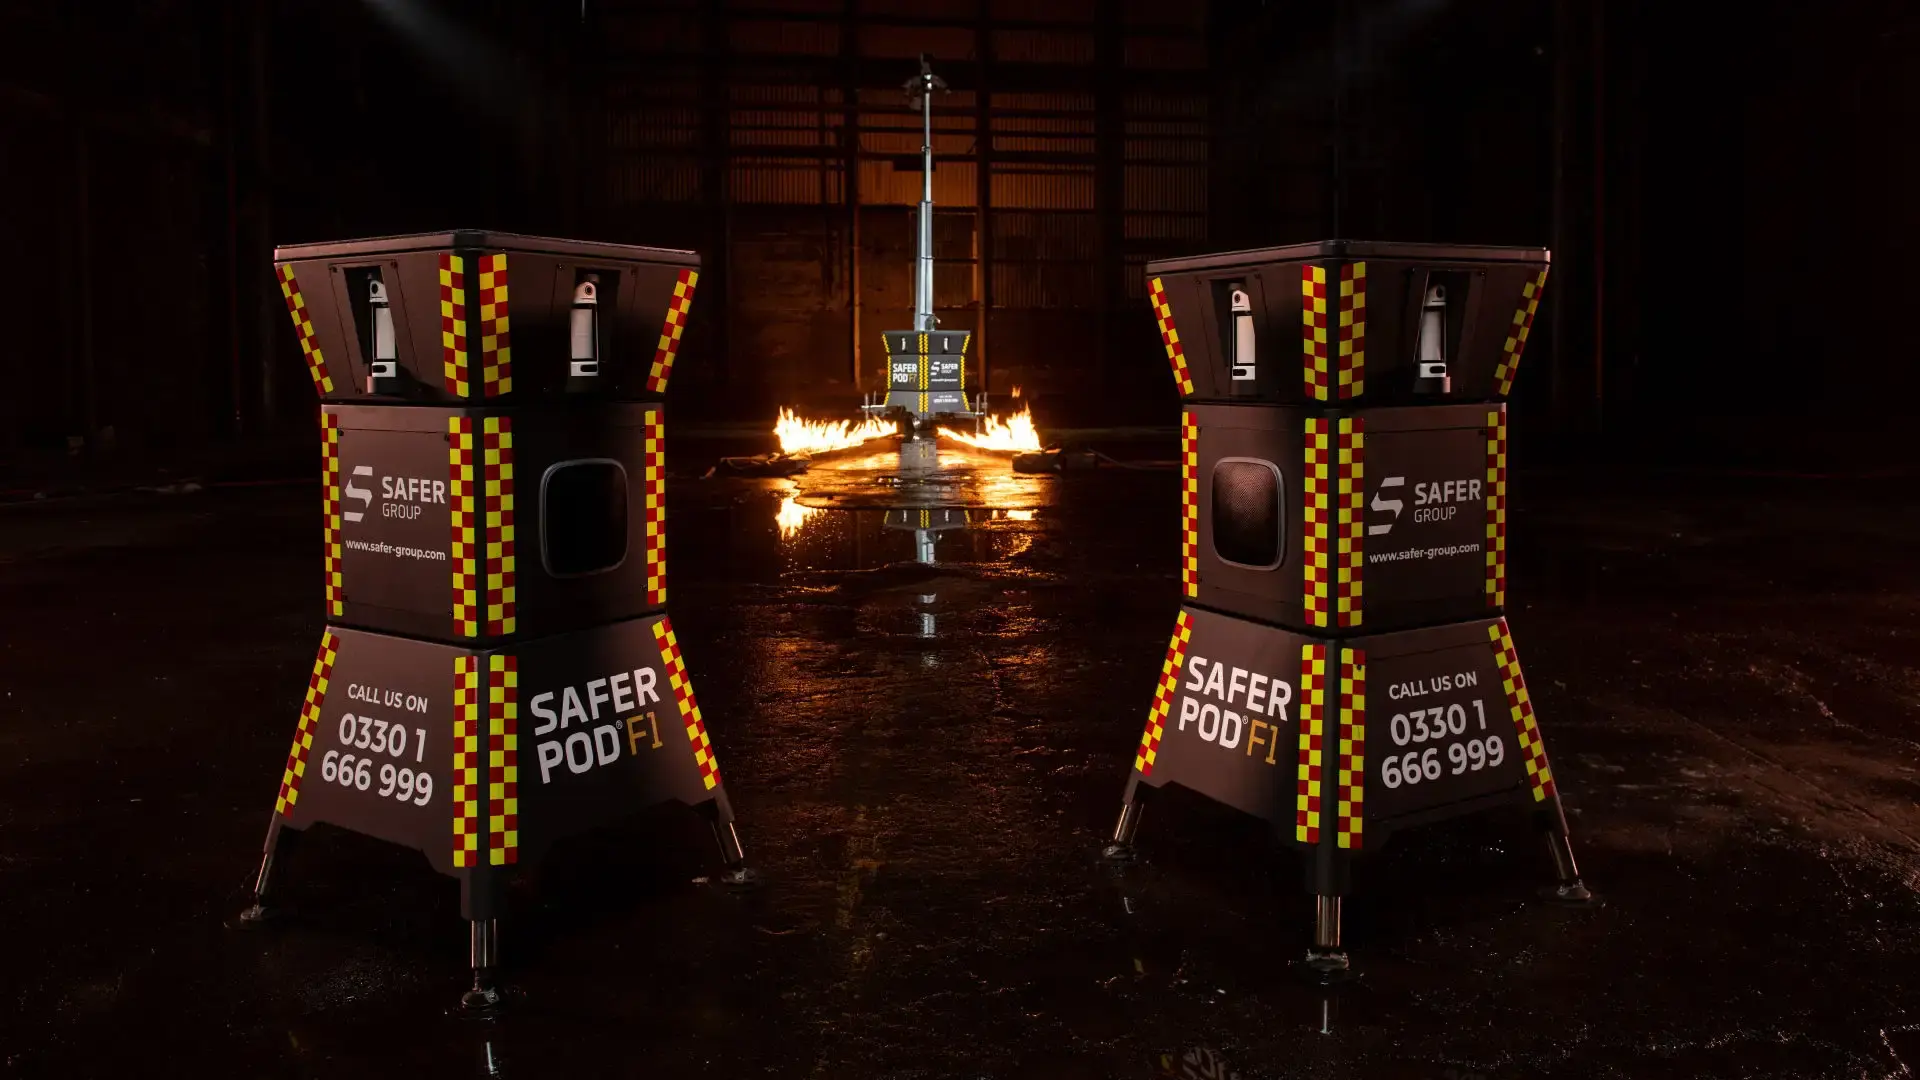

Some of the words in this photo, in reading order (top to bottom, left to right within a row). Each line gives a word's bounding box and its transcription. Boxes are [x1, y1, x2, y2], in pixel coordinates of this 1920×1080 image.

[892, 363, 917, 373] SAFER
[381, 475, 446, 505] SAFER
[1414, 478, 1482, 506] SAFER
[381, 502, 422, 520] GROUP
[1413, 505, 1457, 524] GROUP
[345, 539, 447, 561] www.safer-group.com
[1369, 542, 1480, 564] www.safer-group.com
[347, 682, 381, 706] CALL
[384, 690, 403, 709] US
[405, 694, 428, 714] ON
[529, 666, 661, 736] SAFER
[1184, 655, 1293, 722] SAFER
[1388, 678, 1429, 701] CALL
[1431, 675, 1452, 693] US
[1454, 670, 1478, 690] ON
[338, 713, 408, 758] 0330
[415, 728, 427, 763] 1
[626, 711, 664, 756] F1
[1389, 703, 1468, 747] 0330
[1473, 699, 1487, 731] 1
[1246, 719, 1280, 766] F1
[1380, 747, 1442, 790] 666
[1447, 734, 1505, 776] 999
[321, 750, 372, 791] 666
[379, 763, 434, 807] 999
